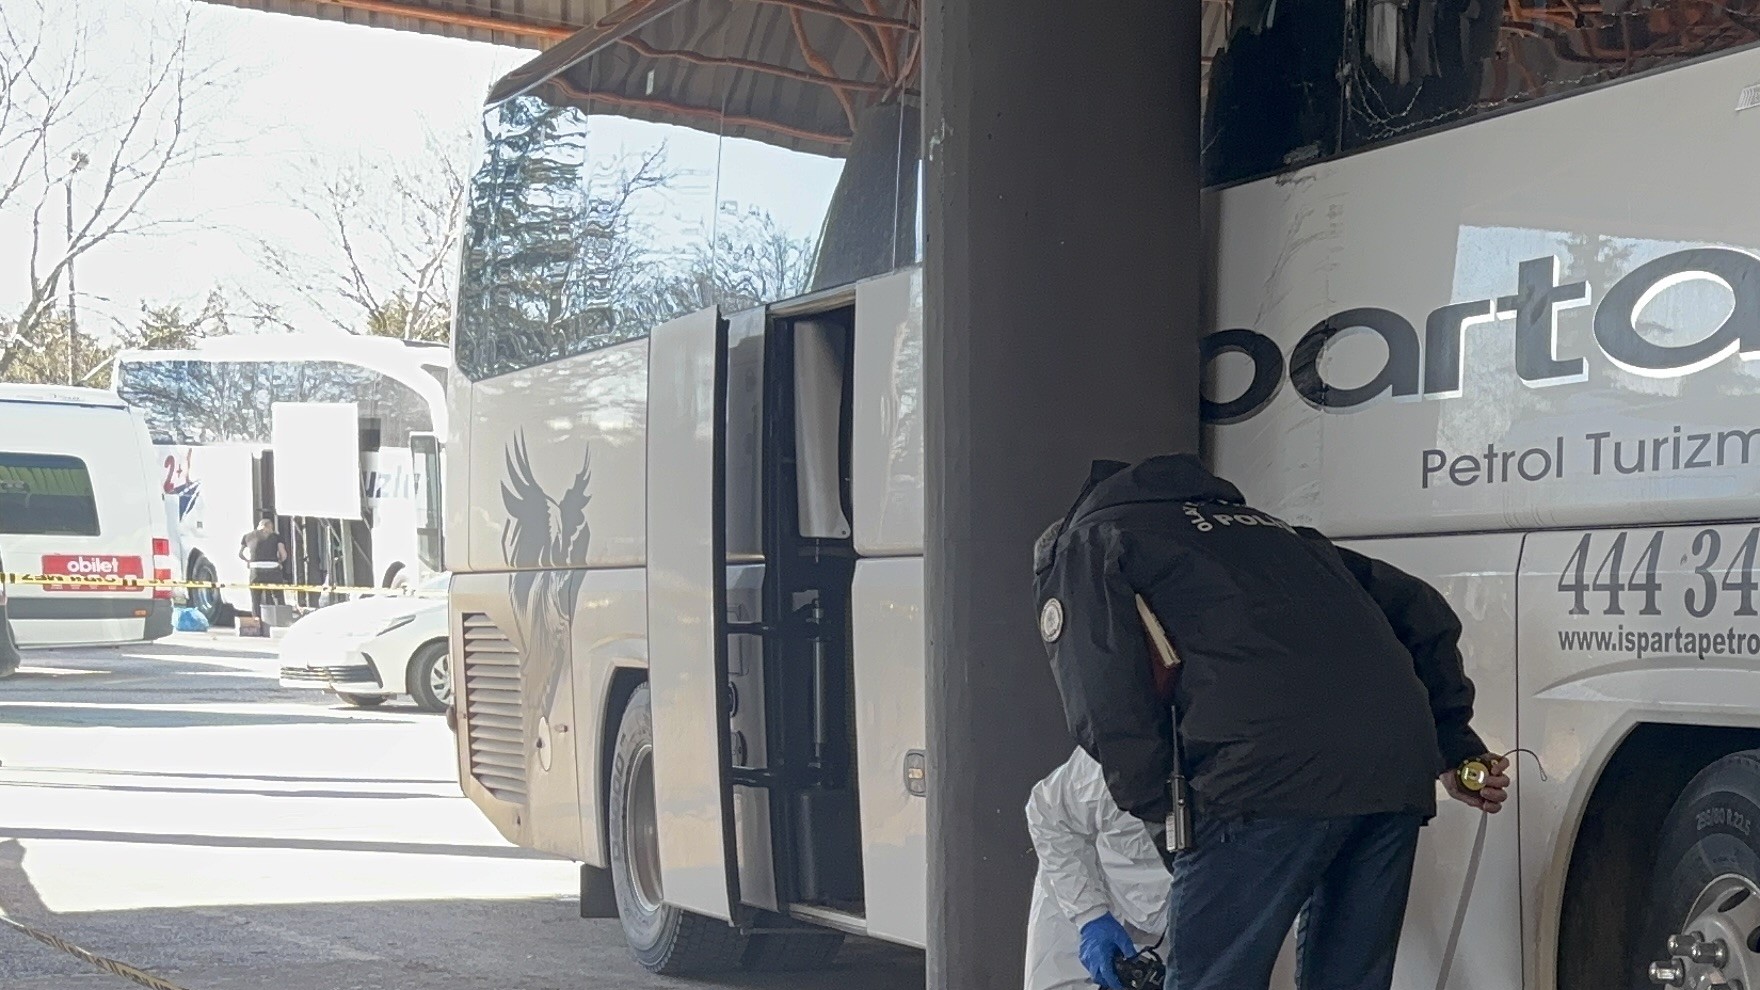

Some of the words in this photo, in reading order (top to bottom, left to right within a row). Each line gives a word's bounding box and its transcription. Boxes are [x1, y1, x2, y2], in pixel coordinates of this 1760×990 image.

[1421, 436, 1564, 489] Petrol
[67, 556, 119, 573] obilet
[1557, 530, 1665, 616] 444
[1684, 526, 1760, 618] 34
